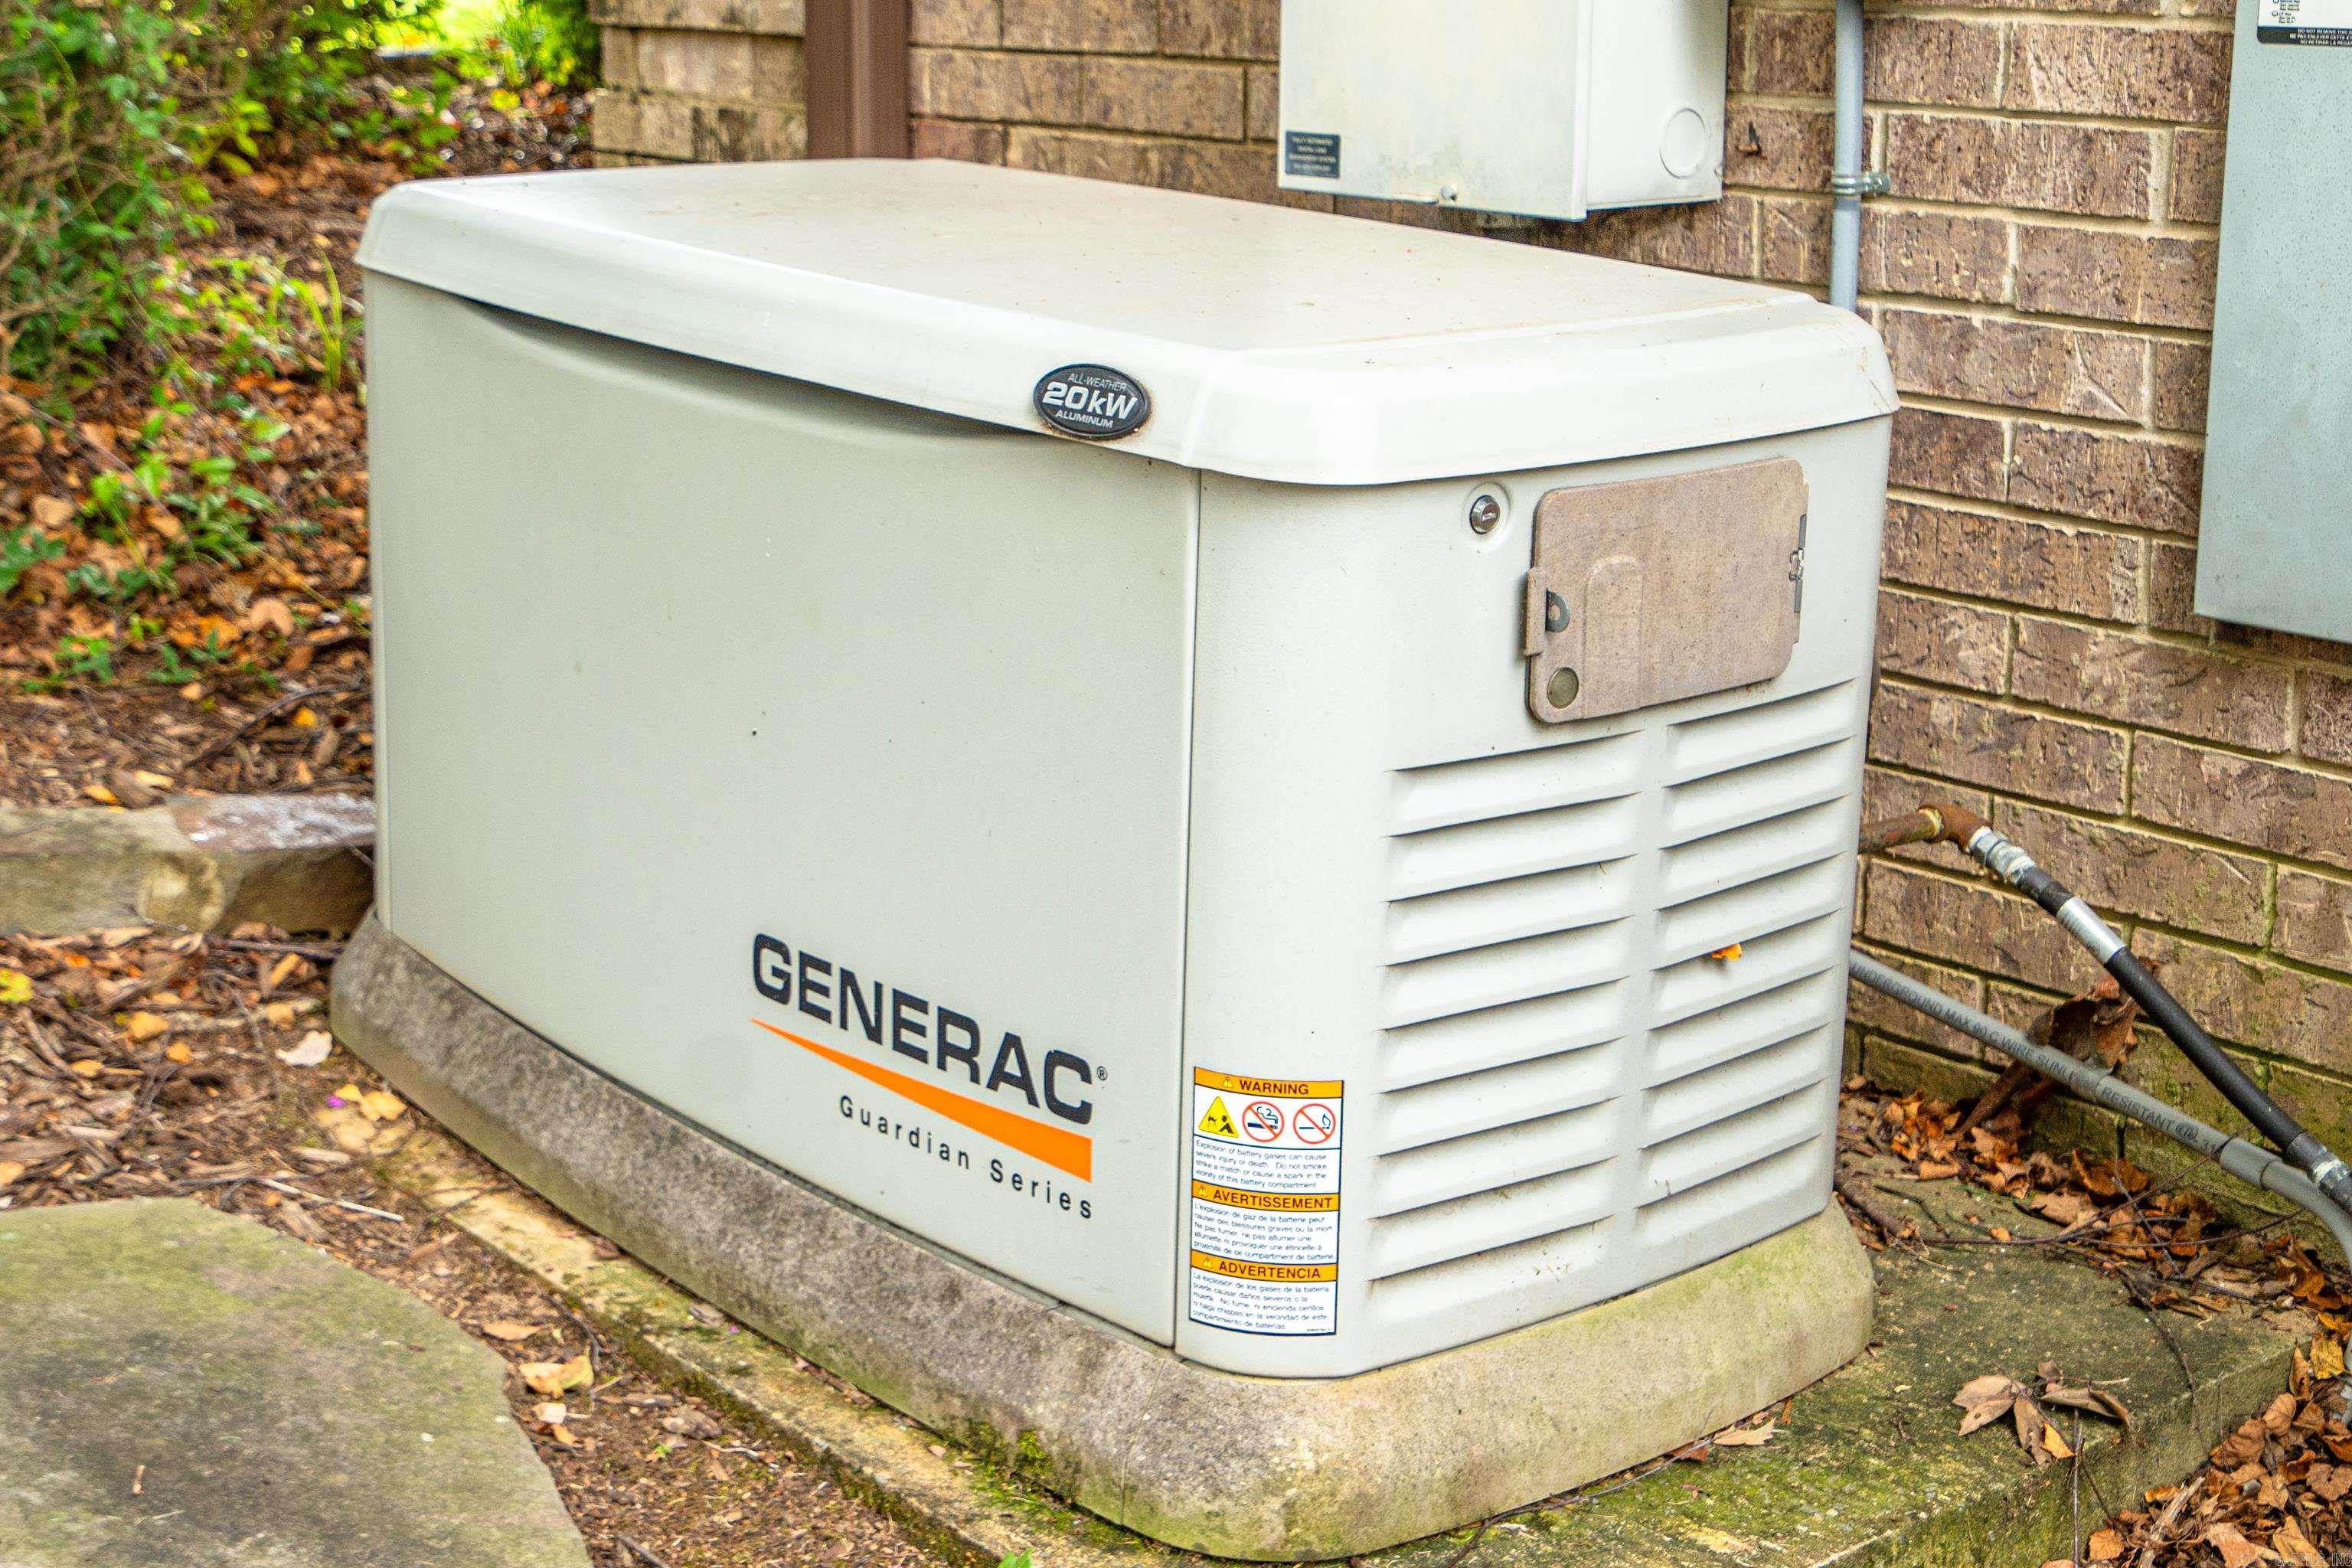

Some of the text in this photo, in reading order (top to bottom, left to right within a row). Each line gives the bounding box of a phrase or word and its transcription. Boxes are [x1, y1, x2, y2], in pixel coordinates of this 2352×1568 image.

[1067, 373, 1127, 392] ALL-WEATHER
[1055, 410, 1113, 428] ALUMINUM
[1240, 1080, 1309, 1095] WARNING
[839, 1095, 1091, 1219] Guardian Series
[1214, 1190, 1332, 1208] AVERTISSEMENT
[1219, 1261, 1321, 1279] ADVERTENCIA
